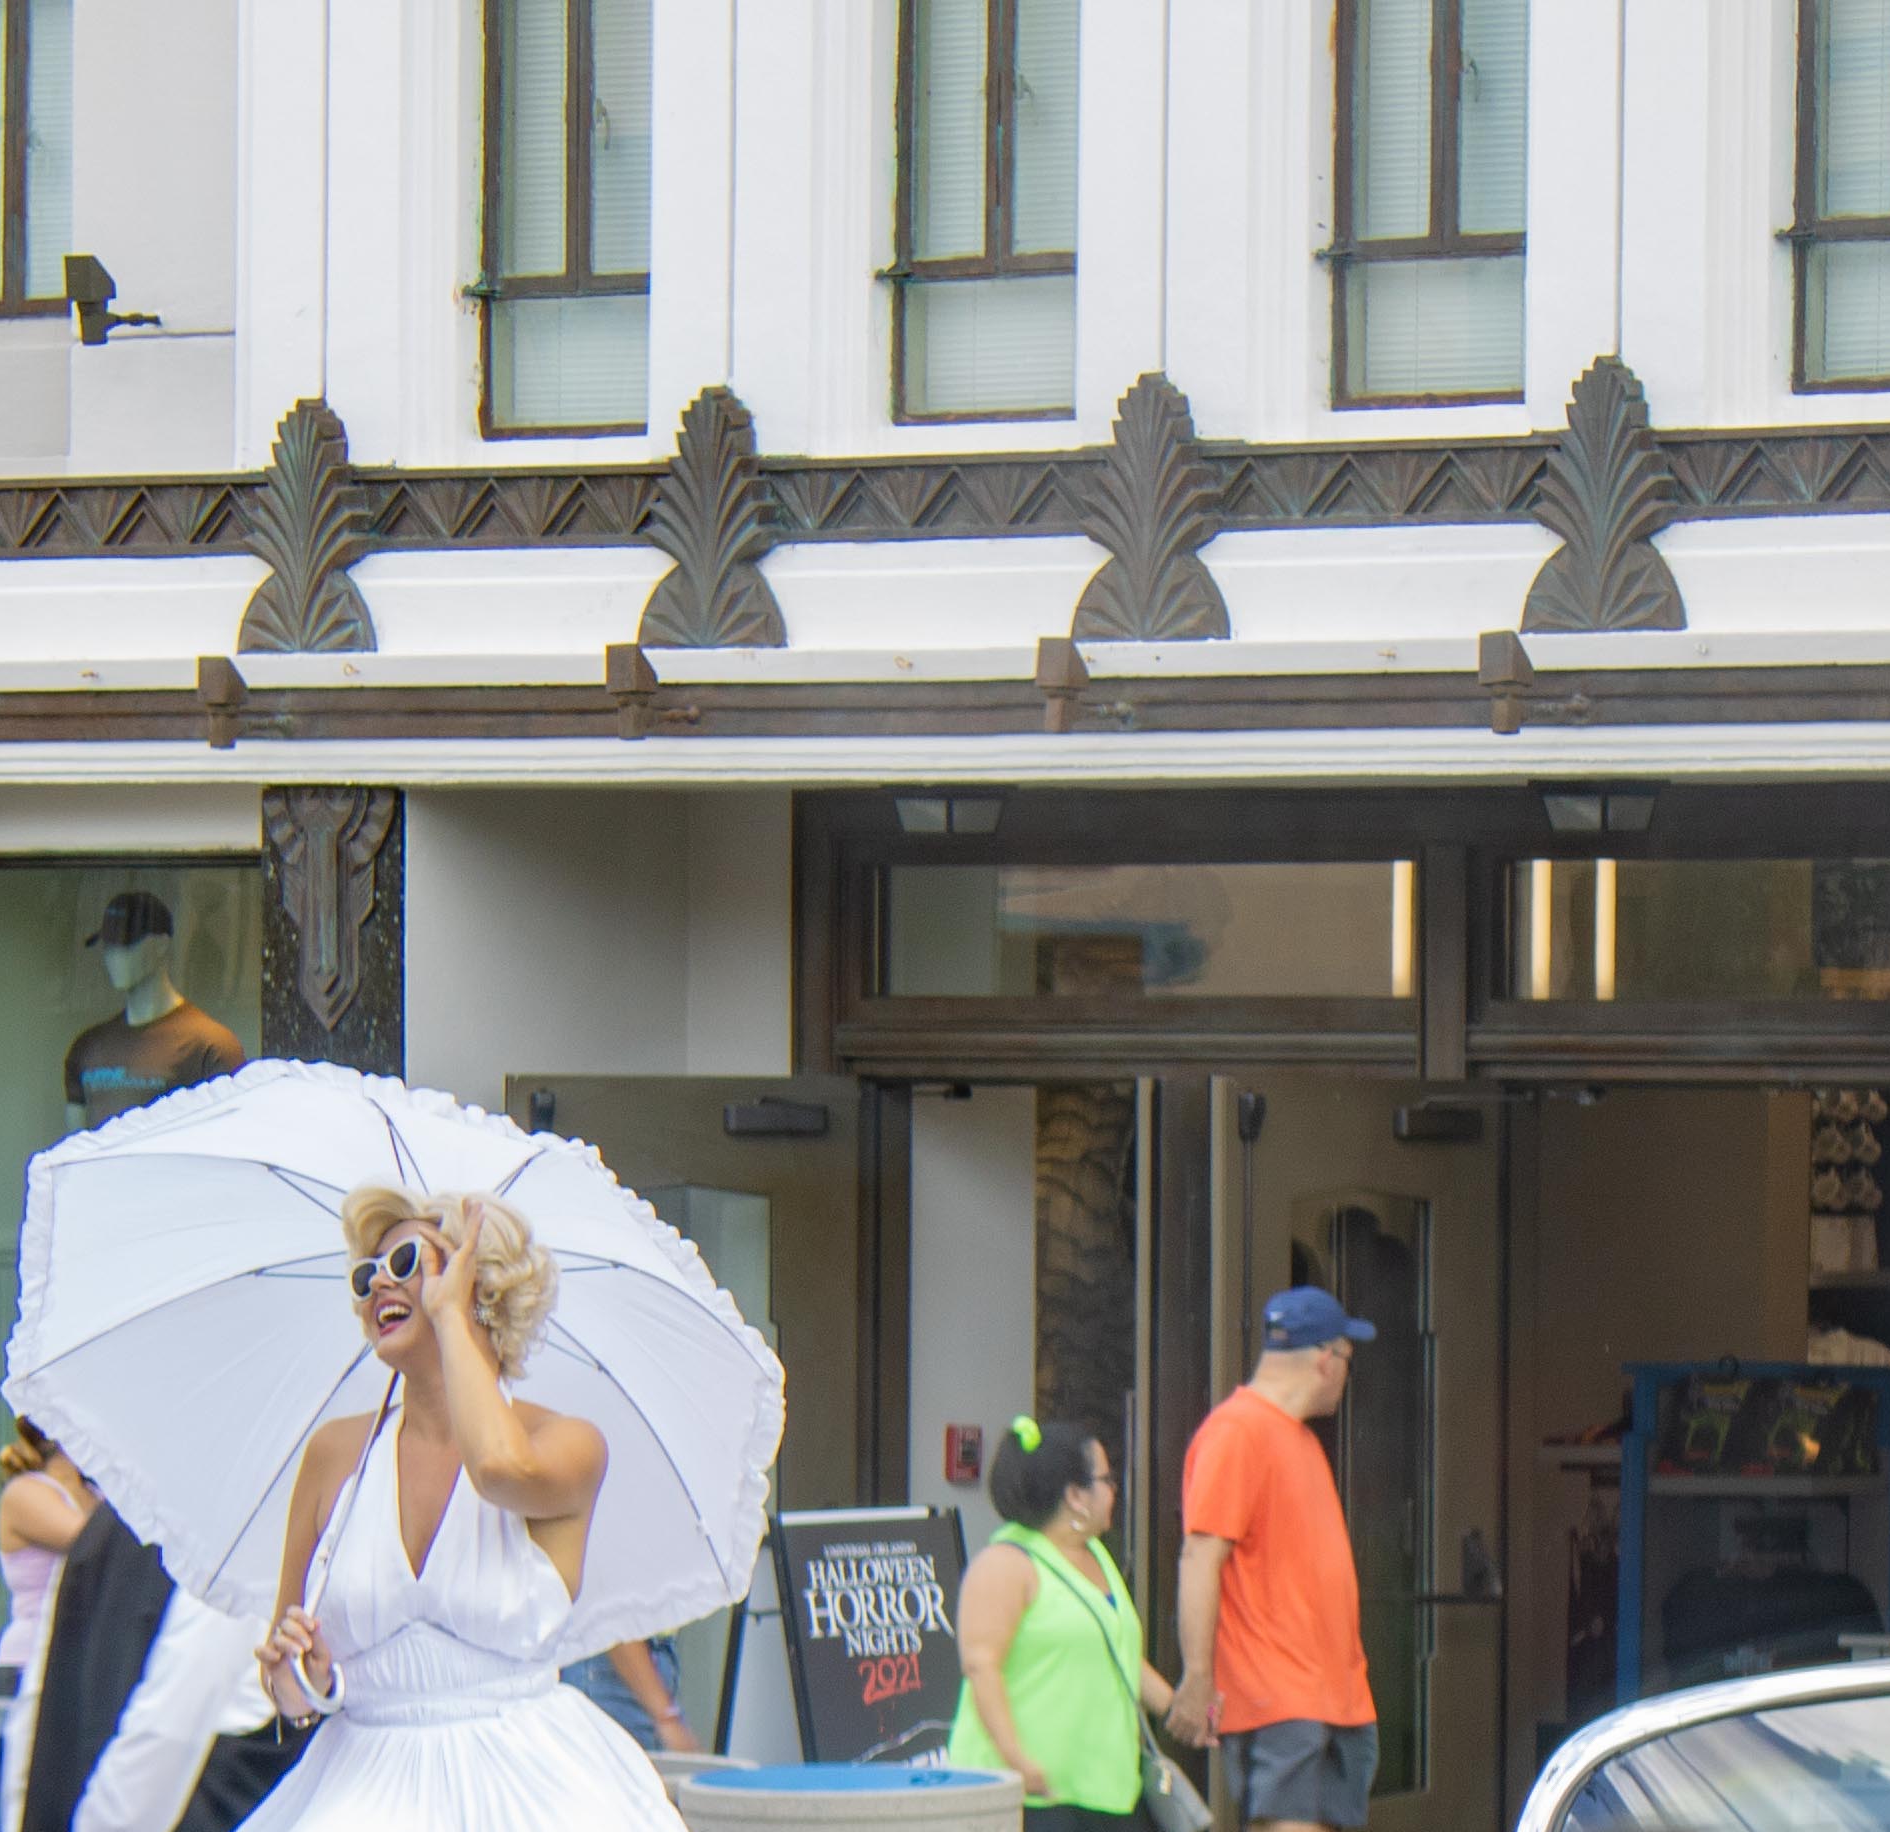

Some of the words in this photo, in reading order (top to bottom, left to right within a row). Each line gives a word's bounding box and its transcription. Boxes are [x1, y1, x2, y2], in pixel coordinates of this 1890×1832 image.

[807, 1553, 937, 1592] HALLOWEEN
[803, 1581, 957, 1640] HORROR
[844, 1625, 923, 1658] NIGHTS
[858, 1652, 922, 1706] 2021
